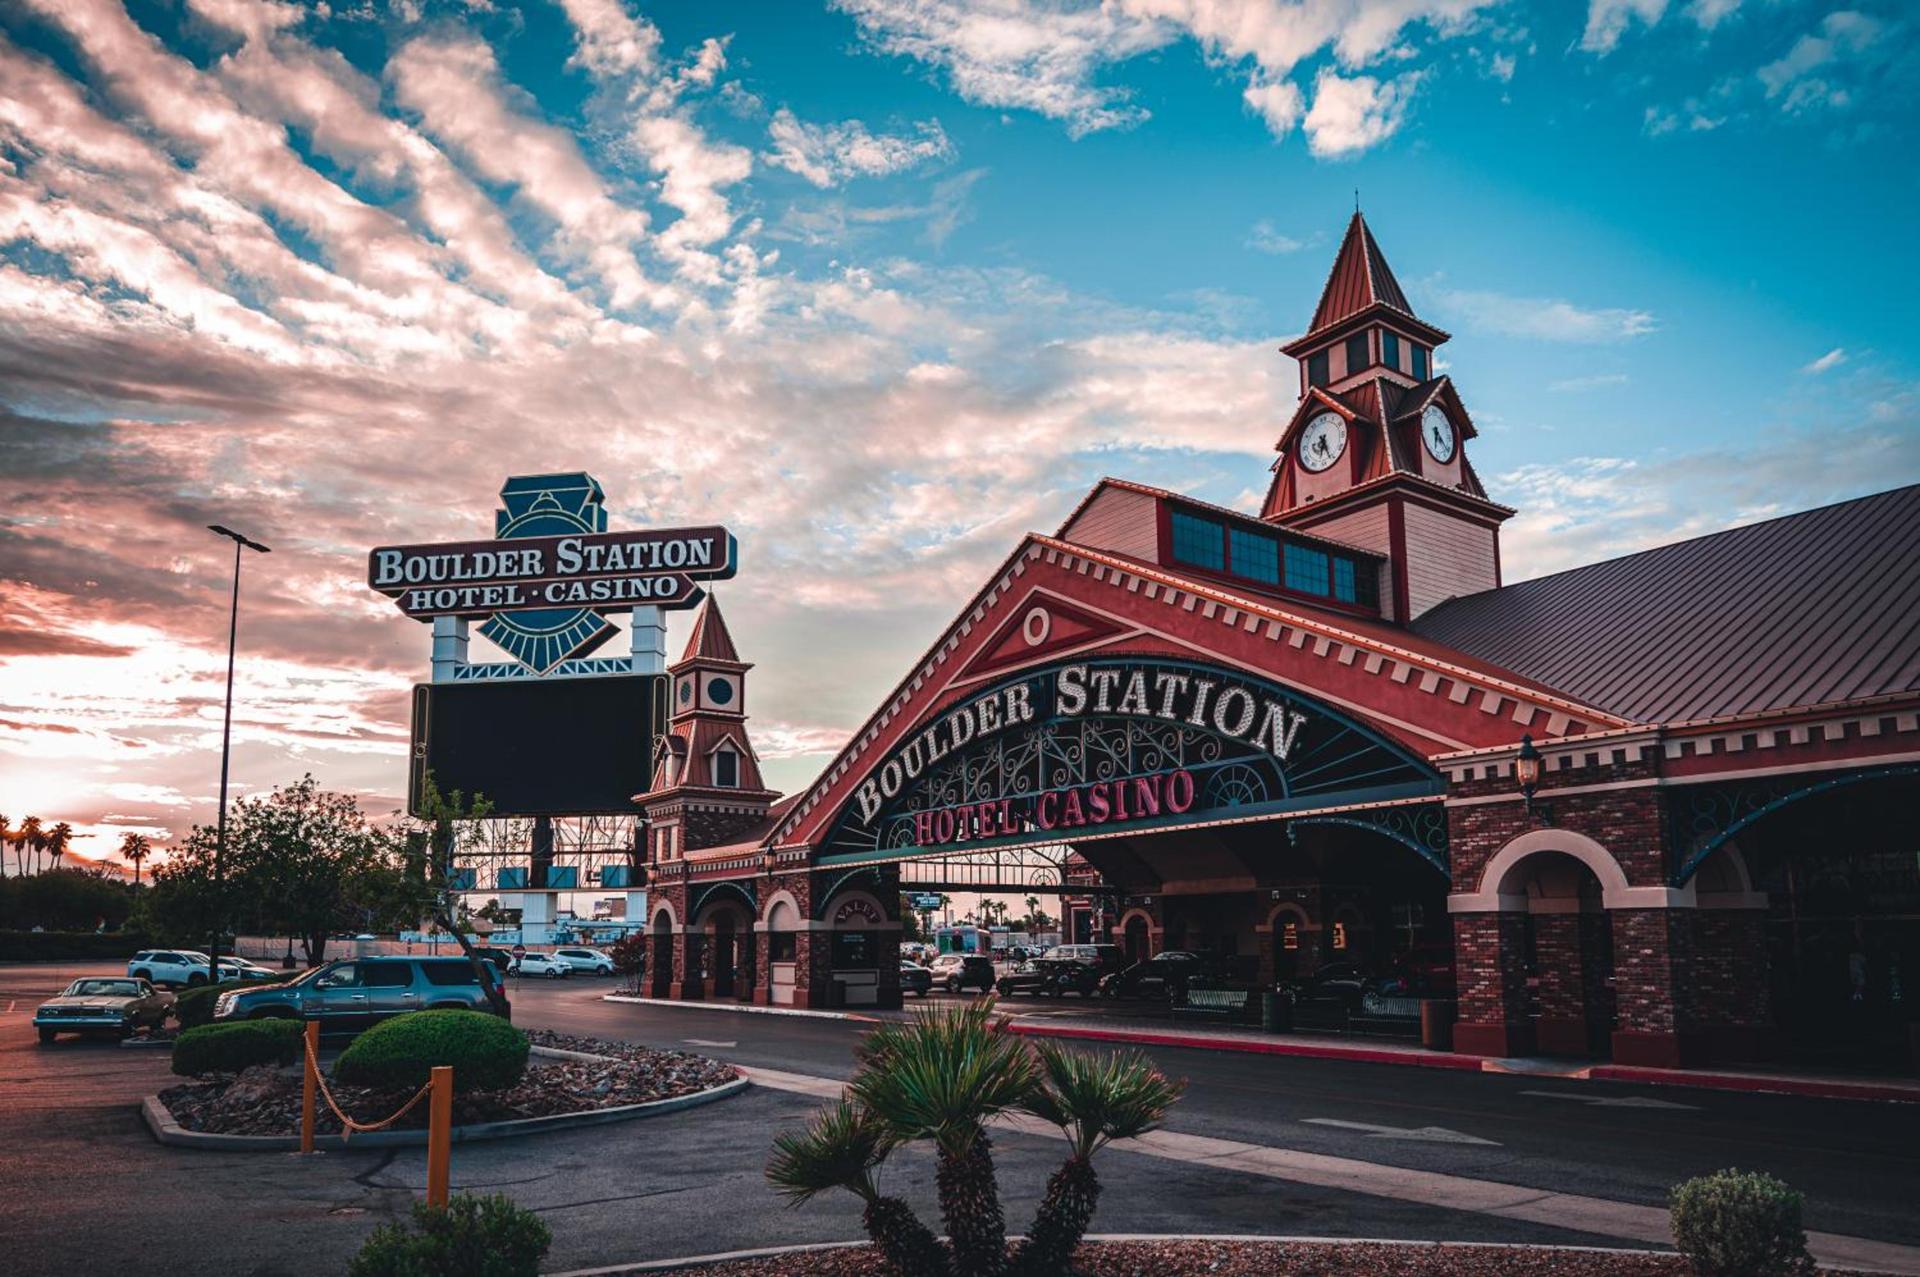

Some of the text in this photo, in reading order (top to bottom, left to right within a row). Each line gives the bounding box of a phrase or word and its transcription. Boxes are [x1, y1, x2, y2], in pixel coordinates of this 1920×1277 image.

[375, 537, 714, 585] BOULDER STATION
[408, 576, 678, 611] HOTEL CASINO
[855, 664, 1307, 826] BOULDER STATION
[914, 769, 1194, 846] HOTEL CASINO
[837, 901, 880, 921] VALET
